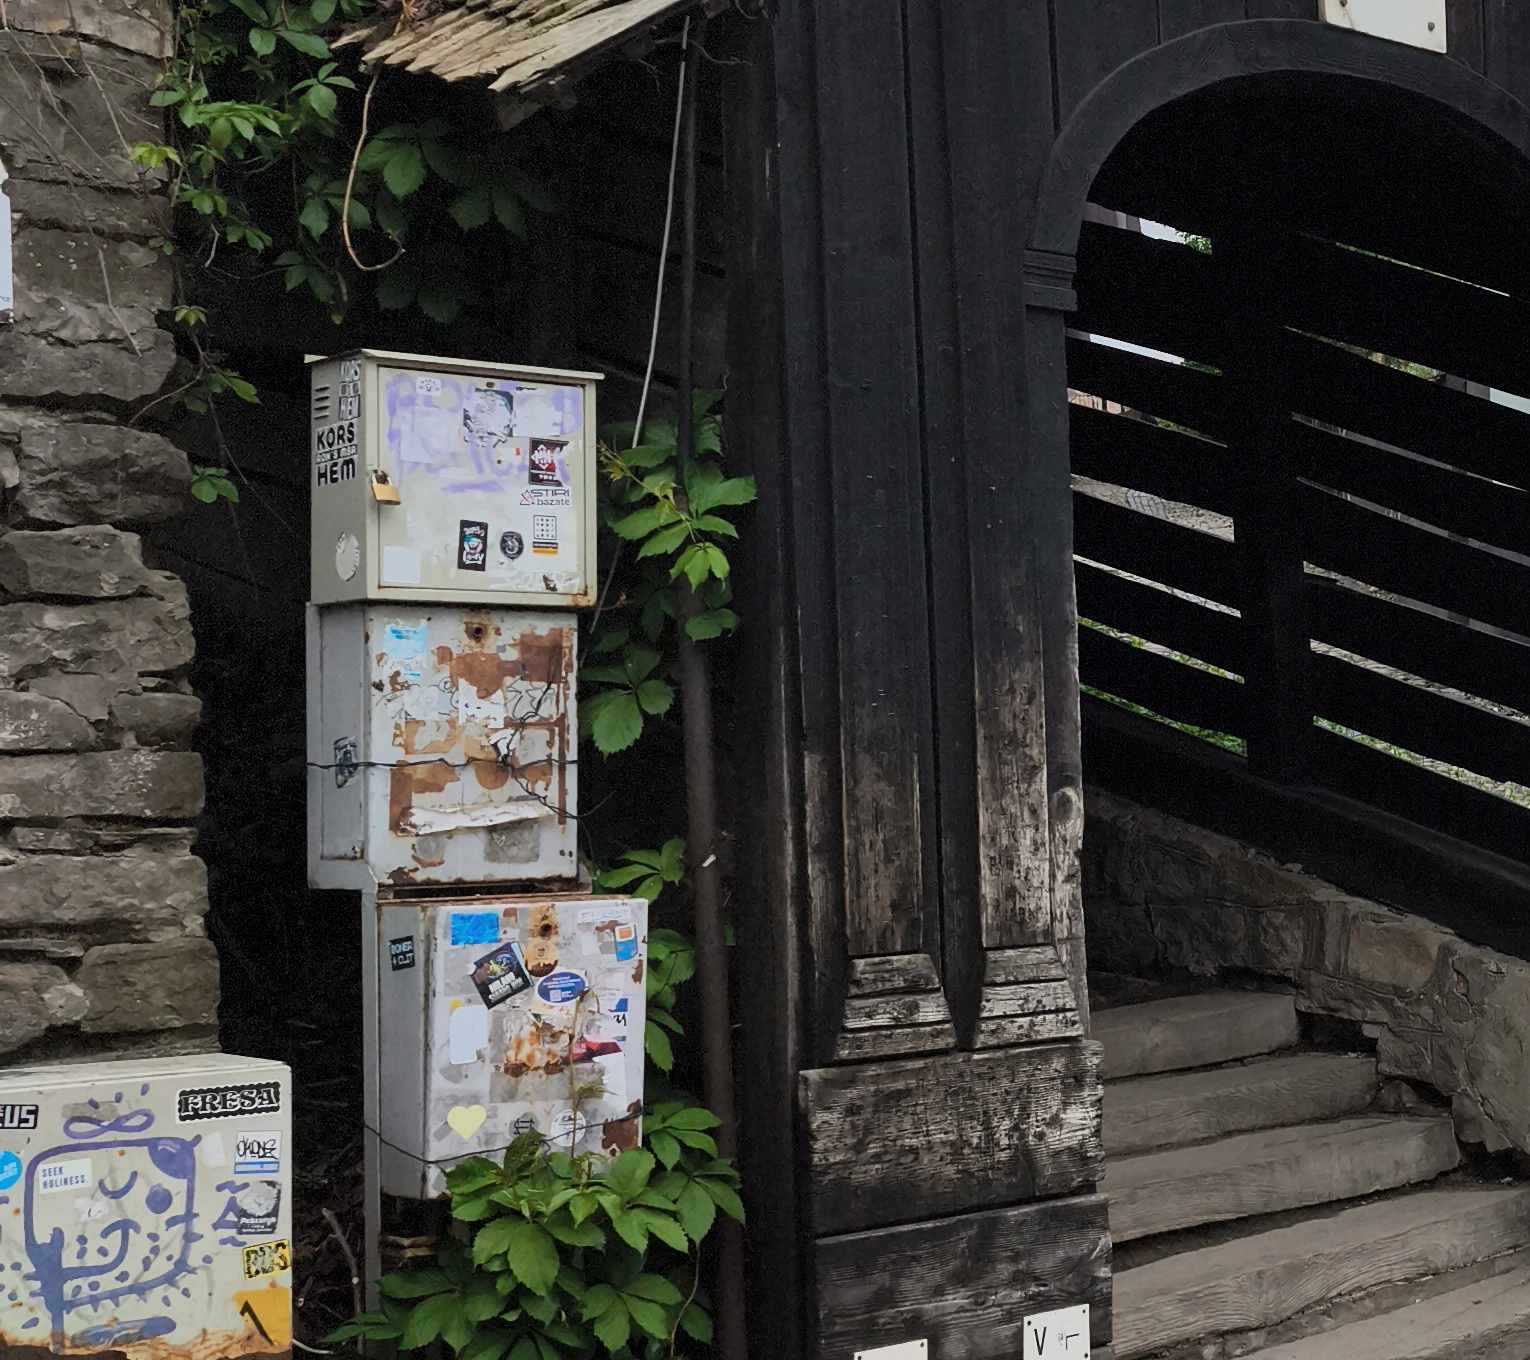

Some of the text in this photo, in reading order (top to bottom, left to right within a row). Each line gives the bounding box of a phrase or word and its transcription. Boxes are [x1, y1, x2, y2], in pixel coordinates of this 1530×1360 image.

[316, 421, 355, 451] KORS
[316, 457, 356, 487] HEM
[537, 498, 570, 506] bazate
[0, 1105, 36, 1128] US
[180, 1087, 278, 1117] FRESA
[42, 1166, 63, 1178] SEEK
[1033, 1326, 1047, 1356] V
